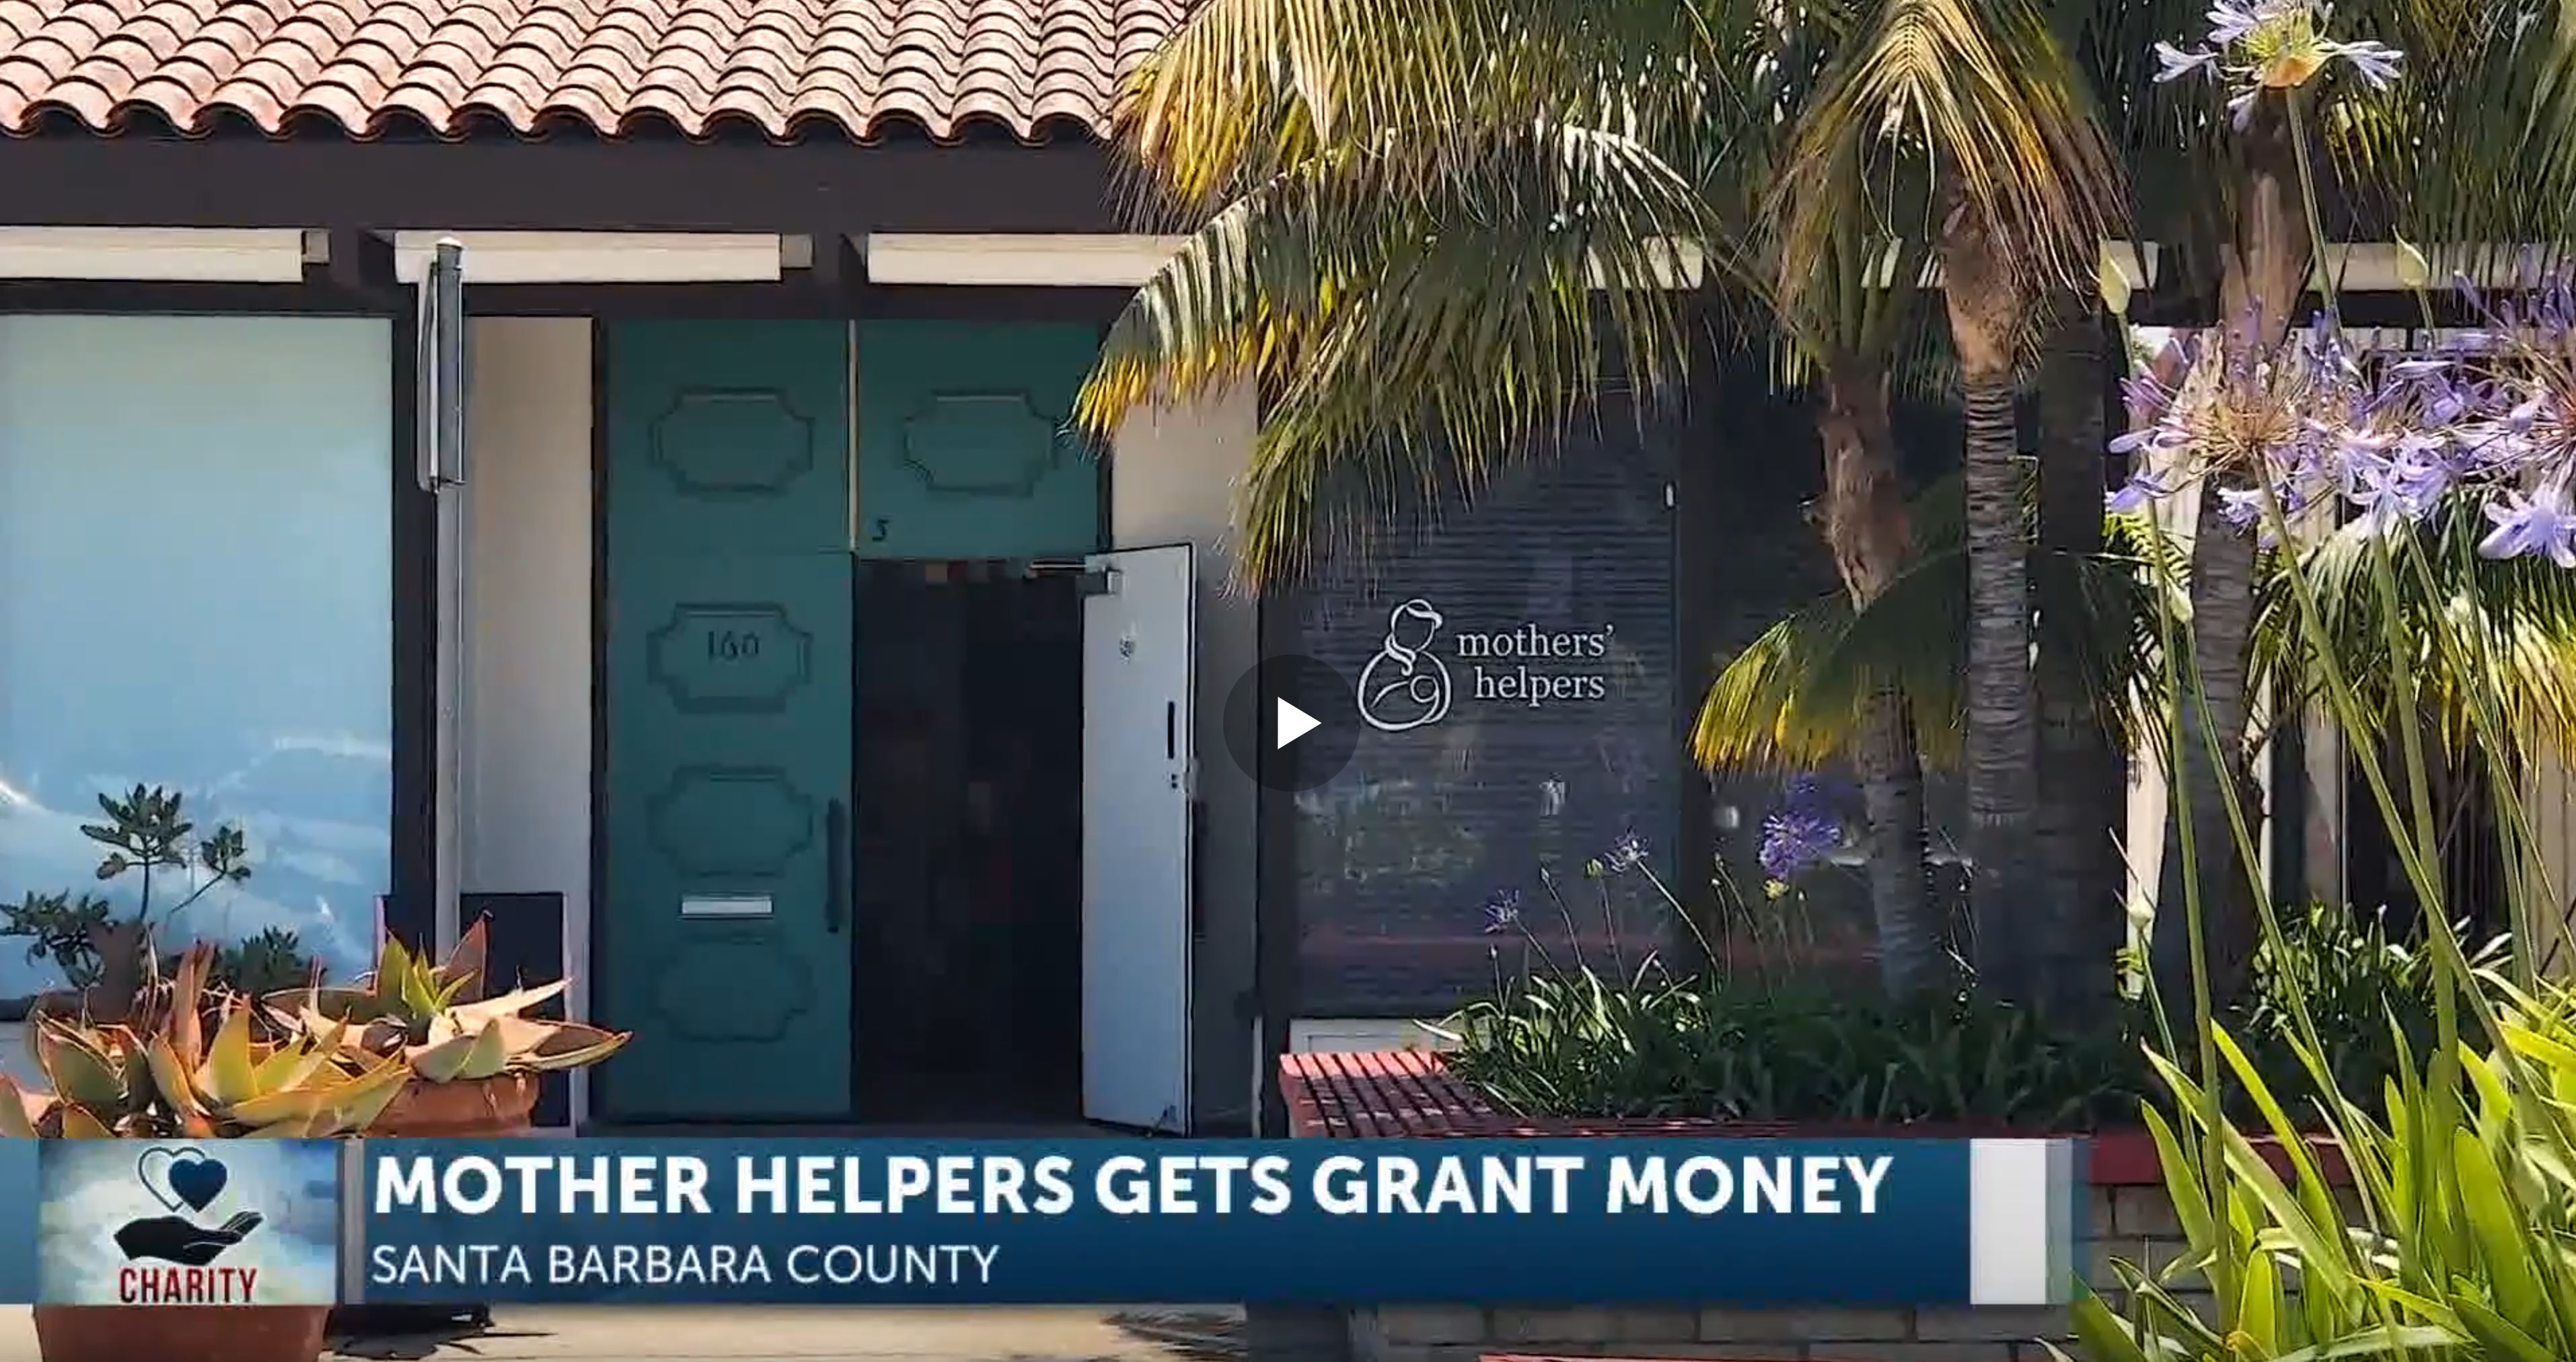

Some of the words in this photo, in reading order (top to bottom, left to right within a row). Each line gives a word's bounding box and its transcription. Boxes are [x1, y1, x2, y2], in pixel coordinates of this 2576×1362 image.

[708, 630, 760, 660] 160
[1457, 623, 1614, 657] mothers'
[1474, 665, 1605, 708] helpers
